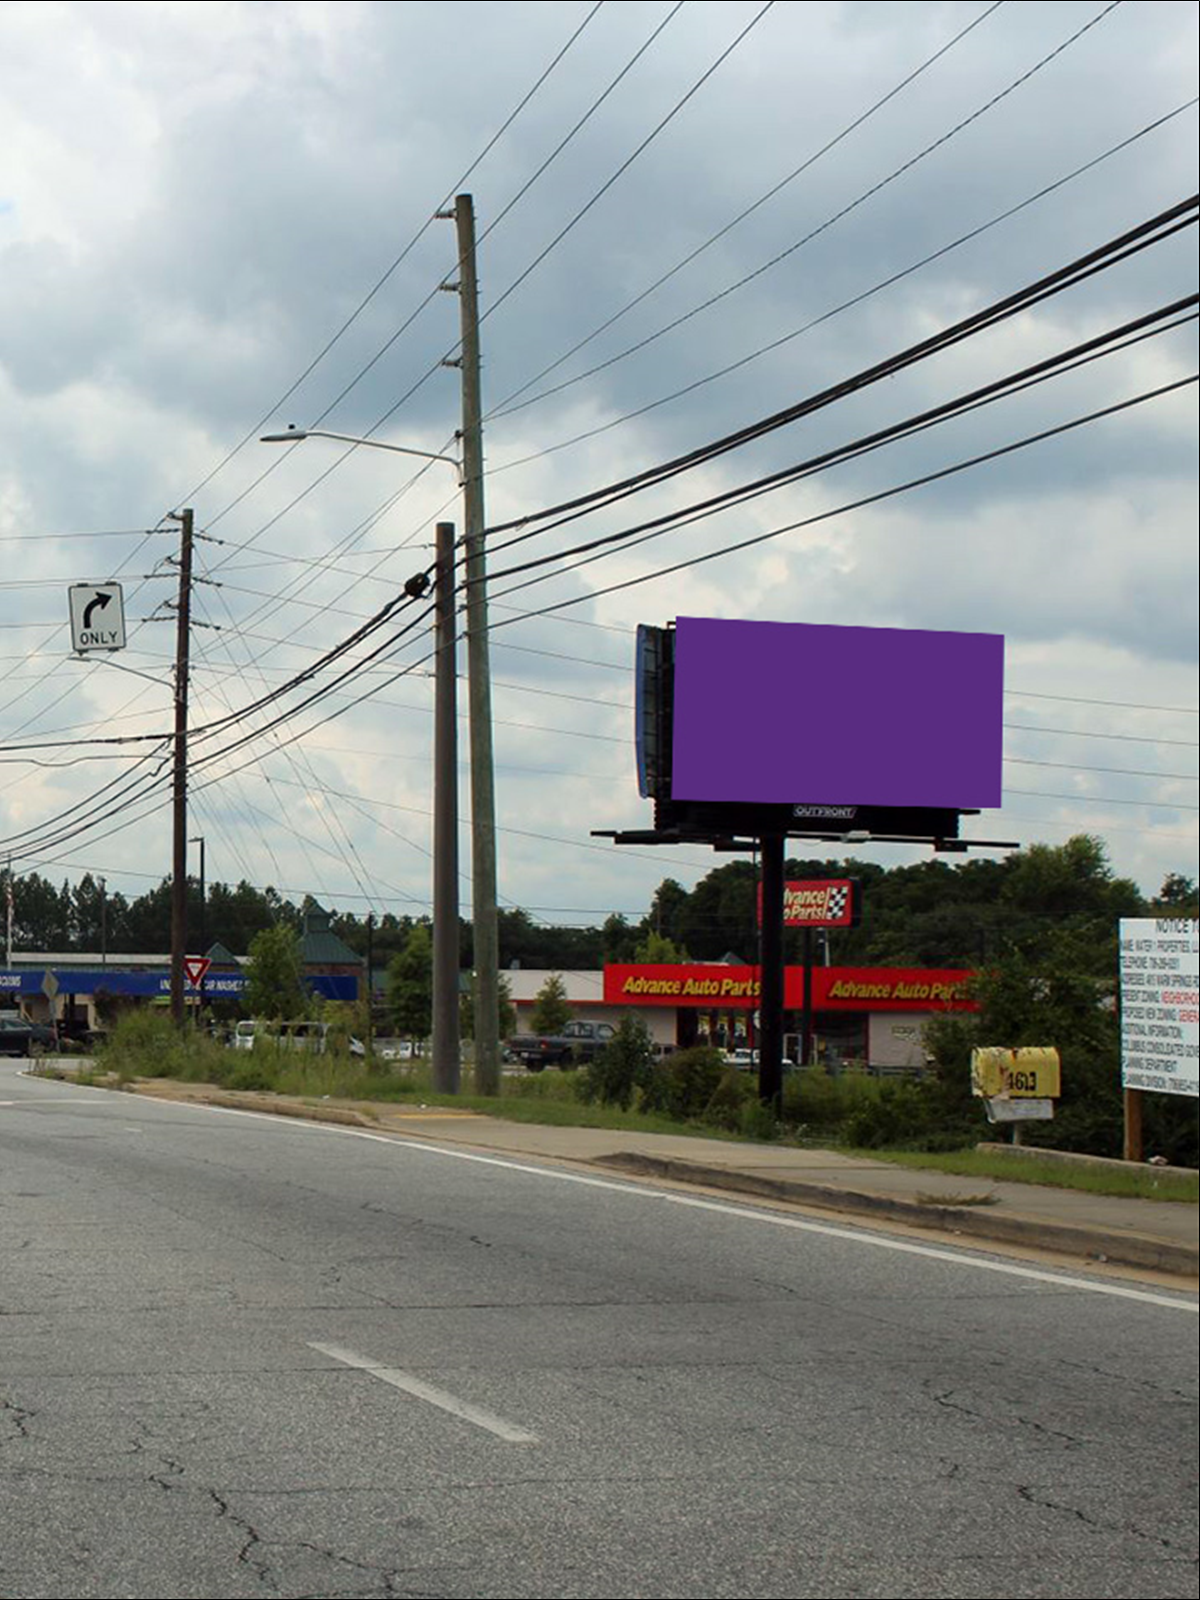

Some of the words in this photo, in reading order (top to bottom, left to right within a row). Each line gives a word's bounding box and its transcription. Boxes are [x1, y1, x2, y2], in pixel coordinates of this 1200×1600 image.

[80, 631, 117, 646] ONLY
[796, 806, 853, 818] OUTFRONT
[783, 888, 827, 905] vance
[791, 905, 824, 920] Parts
[623, 976, 680, 994] Advance
[682, 978, 719, 995] Auto
[720, 978, 761, 996] Parts
[829, 981, 891, 998] Advance
[892, 982, 929, 998] Auto
